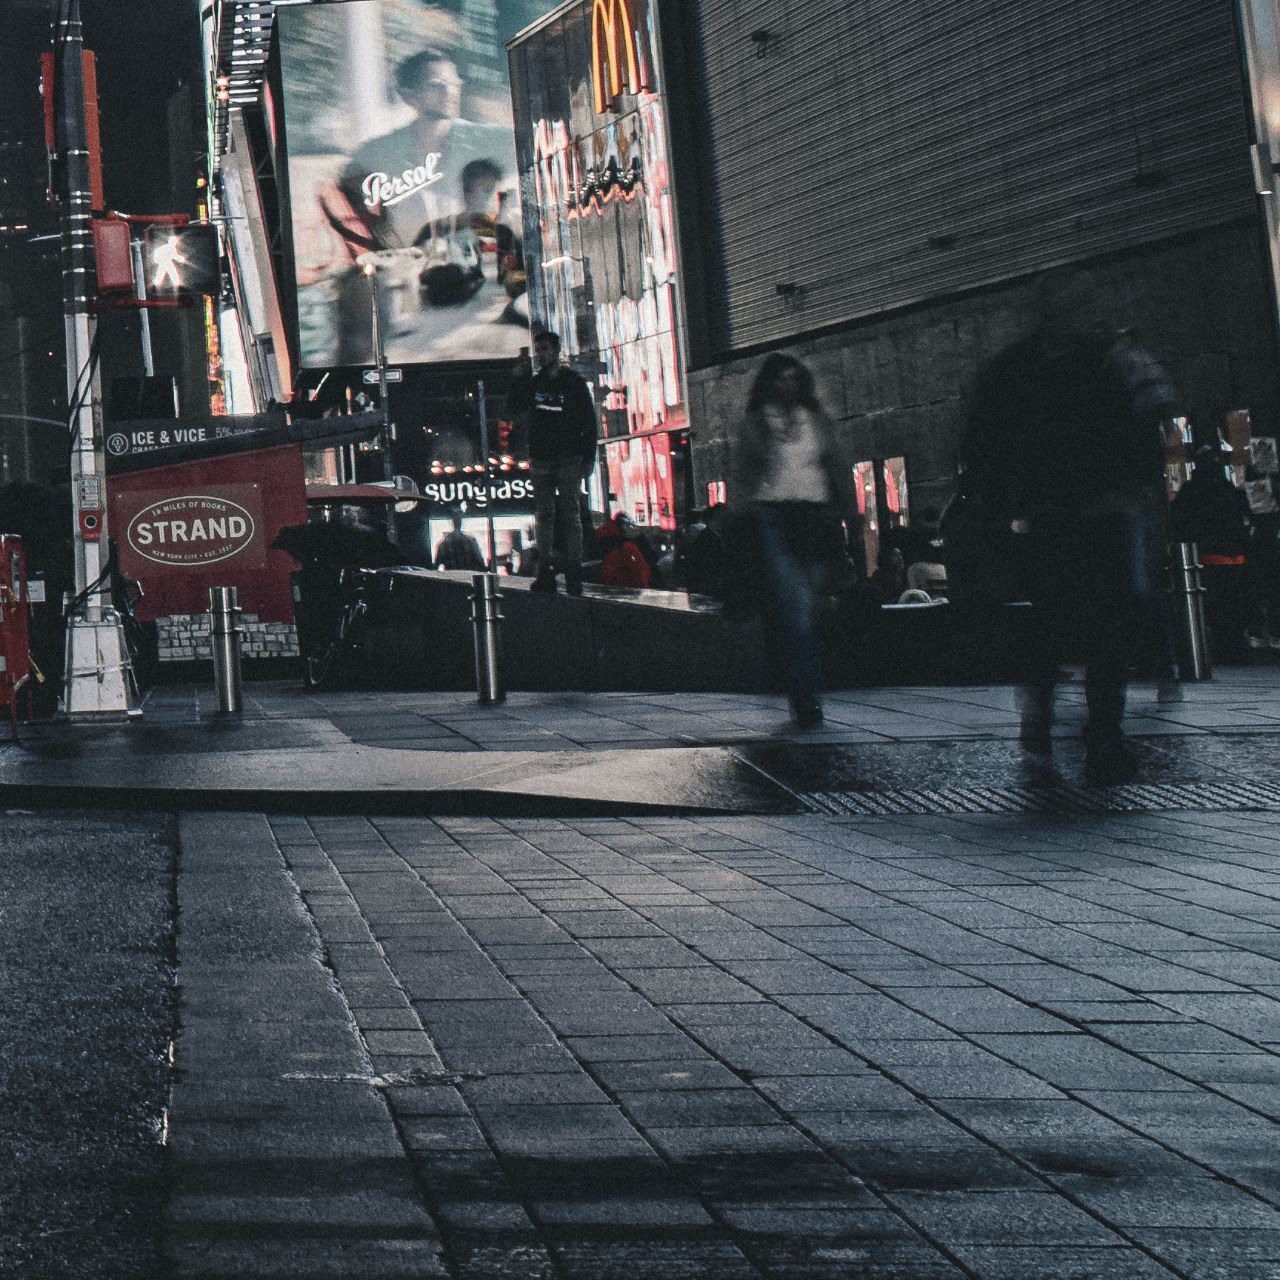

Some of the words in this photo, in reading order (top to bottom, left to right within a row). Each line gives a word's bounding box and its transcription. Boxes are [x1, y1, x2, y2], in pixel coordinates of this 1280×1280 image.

[361, 152, 443, 207] Persol
[131, 430, 155, 446] ICE
[159, 430, 171, 444] &
[173, 427, 207, 443] VICE
[163, 502, 186, 512] MILES
[201, 501, 227, 512] BOOKS
[137, 516, 247, 545] STRAND
